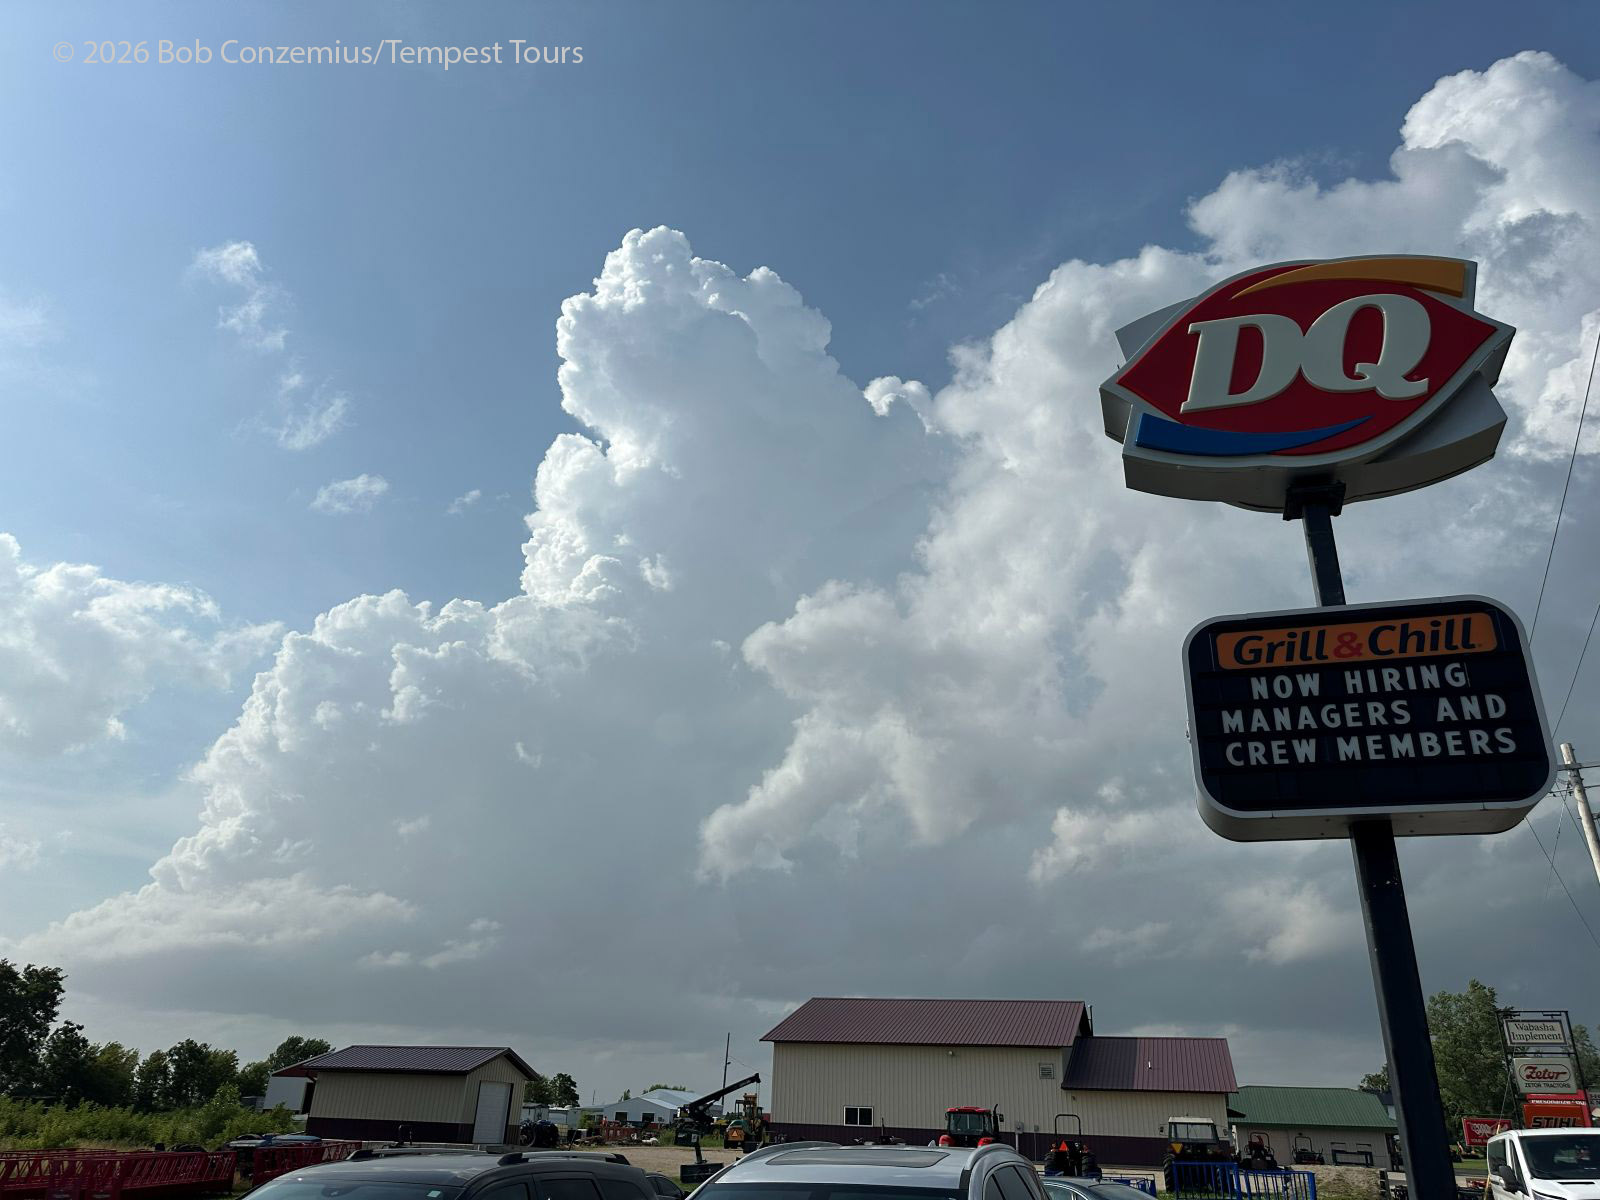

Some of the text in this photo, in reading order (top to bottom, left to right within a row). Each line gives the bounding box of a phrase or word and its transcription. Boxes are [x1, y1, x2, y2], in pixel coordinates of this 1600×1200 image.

[1180, 293, 1431, 413] DQ
[1233, 629, 1328, 666] Grill
[1368, 617, 1476, 657] Chill
[1250, 662, 1467, 700] NOW HIRING
[1221, 694, 1507, 734] MANAGERS AND
[1225, 728, 1517, 766] CREW MEMBERS
[1511, 1031, 1562, 1041] Implement
[1514, 1023, 1555, 1031] Wabasha
[1524, 1065, 1567, 1080] Zetor
[1532, 1117, 1583, 1128] STIHL
